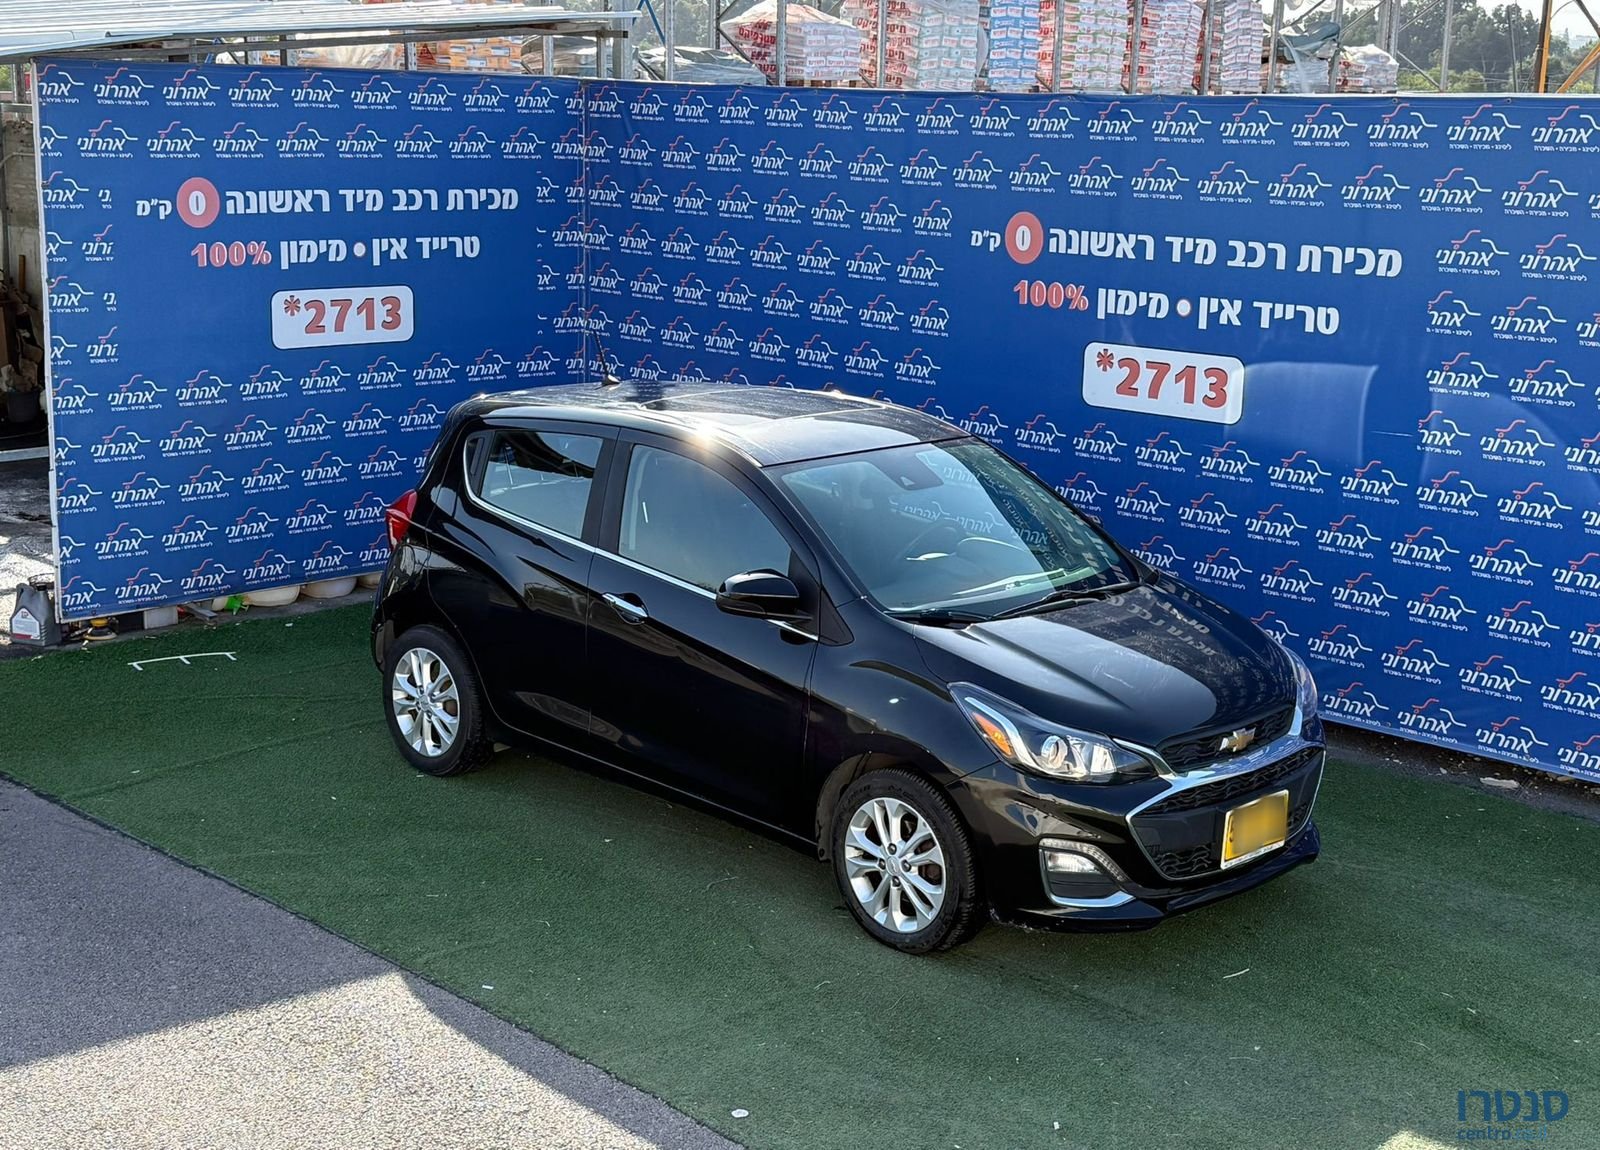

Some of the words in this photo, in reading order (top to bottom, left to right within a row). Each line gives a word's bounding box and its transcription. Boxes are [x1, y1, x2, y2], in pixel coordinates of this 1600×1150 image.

[164, 85, 210, 101] אהרוני
[229, 87, 273, 102] אהרוני
[352, 89, 391, 105] אהרוני
[409, 92, 447, 106] אהרוני
[516, 95, 550, 108] אהרוני
[630, 102, 660, 116] אהרוני
[718, 105, 750, 119] אהרוני
[813, 110, 847, 123] אהרוני
[916, 112, 954, 129] אהרוני
[970, 115, 1009, 130] אהרוני
[1027, 115, 1069, 133] אהרוני
[1087, 117, 1131, 135] אהרוני
[1152, 120, 1199, 136] אהרוני
[1220, 122, 1270, 137] אהרוני
[1291, 121, 1344, 141] אהרוני
[1367, 124, 1423, 140] אהרוני
[1446, 126, 1505, 142] אהרוני
[1531, 127, 1592, 144] אהרוני
[78, 137, 126, 152] אהרוני
[148, 137, 194, 153] אהרוני
[278, 137, 319, 153] אהרוני
[338, 138, 377, 153] אהרוני
[450, 140, 487, 154] אהרוני
[502, 141, 537, 154] אהרוני
[662, 150, 692, 164] אהרוני
[751, 155, 784, 170] אהרוני
[848, 162, 884, 176] אהרוני
[953, 167, 992, 183] אהרוני
[1009, 171, 1050, 186] אהרוני
[1068, 174, 1111, 189] אהרוני
[1131, 177, 1176, 192] אהרוני
[1197, 178, 1246, 196] אהרוני
[1267, 183, 1318, 199] אהרוני
[1341, 185, 1395, 202] אהרוני
[190, 190, 204, 215] 0
[226, 190, 329, 214] ראשונה
[339, 190, 383, 211] מיד
[393, 190, 437, 210] רכב
[447, 189, 518, 210] מכירת
[630, 192, 660, 206] אהרוני
[1419, 187, 1476, 205] אהרוני
[1501, 190, 1561, 209] אהרוני
[717, 200, 749, 212] אהרוני
[811, 208, 845, 221] אהרוני
[912, 216, 950, 231] אהרוני
[1017, 225, 1030, 250] 0
[1049, 229, 1154, 260] ראשונה
[192, 241, 271, 267] 100%
[281, 240, 346, 269] מימון
[373, 238, 407, 265] אין
[416, 237, 479, 258] טרייד
[661, 241, 691, 254] אהרוני
[1165, 237, 1216, 264] מיד
[1227, 241, 1286, 269] רכב
[750, 249, 783, 264] אהרוני
[798, 254, 830, 269] אהרוני
[1297, 245, 1402, 277] מכירת
[1436, 249, 1493, 267] אהרוני
[1519, 254, 1579, 273] אהרוני
[897, 264, 933, 280] אהרוני
[673, 286, 703, 299] אהרוני
[1014, 280, 1088, 310] 100%
[762, 296, 795, 311] אהרוני
[1098, 288, 1169, 319] מימון
[858, 309, 894, 323] אהרוני
[1199, 297, 1241, 329] אין
[1253, 302, 1339, 334] טרייד
[619, 322, 648, 337] אהרוני
[1490, 314, 1551, 334] אהרוני
[704, 334, 735, 349] אהרוני
[796, 347, 830, 362] אהרוני
[413, 368, 450, 380] אהרוני
[466, 364, 502, 376] אהרוני
[516, 360, 552, 373] אהרוני
[894, 361, 931, 377] אהרוני
[300, 375, 340, 389] אהרוני
[1426, 369, 1484, 389] אהרוני
[176, 386, 220, 400] אהרוני
[239, 381, 282, 395] אהרוני
[1508, 378, 1569, 398] אהרוני
[342, 418, 382, 432] אהרוני
[398, 414, 436, 427] אהרוני
[159, 436, 205, 451] אהרוני
[224, 429, 266, 445] אהרוני
[1015, 428, 1055, 445] אהרוני
[1073, 437, 1116, 454] אהרוני
[1479, 437, 1539, 456] אהרוני
[1134, 446, 1180, 465] אהרוני
[302, 466, 341, 480] אהרוני
[358, 460, 397, 474] אהרוני
[1199, 456, 1248, 474] אהרוני
[1268, 466, 1318, 484] אהרוני
[178, 480, 222, 496] אהרוני
[1340, 476, 1393, 495] אהרוני
[1115, 496, 1160, 514] אהרוני
[1416, 487, 1472, 507] אהרוני
[1178, 506, 1226, 525] אהרוני
[1497, 498, 1557, 519] אהרוני
[286, 513, 326, 528] אהרוני
[1245, 518, 1294, 537] אהרוני
[225, 522, 268, 537] אהרוני
[95, 538, 142, 554] אהרוני
[162, 530, 206, 546] אהרוני
[1316, 529, 1368, 549] אהרוני
[1391, 541, 1444, 562] אהרוני
[303, 555, 342, 570] אהרוני
[1470, 554, 1527, 576] אהרוני
[244, 564, 284, 579] אהרוני
[1193, 561, 1240, 581] אהרוני
[115, 583, 161, 598] אהרוני
[1260, 574, 1310, 594] אהרוני
[1332, 586, 1384, 607] אהרוני
[1407, 600, 1462, 622] אהרוני
[1486, 614, 1544, 638] אהרוני
[1308, 637, 1359, 658] אהרוני
[1382, 652, 1435, 674] אהרוני
[1459, 669, 1515, 691] אהרוני
[1324, 695, 1375, 716] אהרוני
[1540, 686, 1598, 709] אהרוני
[1398, 712, 1452, 733] אהרוני
[1476, 729, 1532, 751] אהרוני
